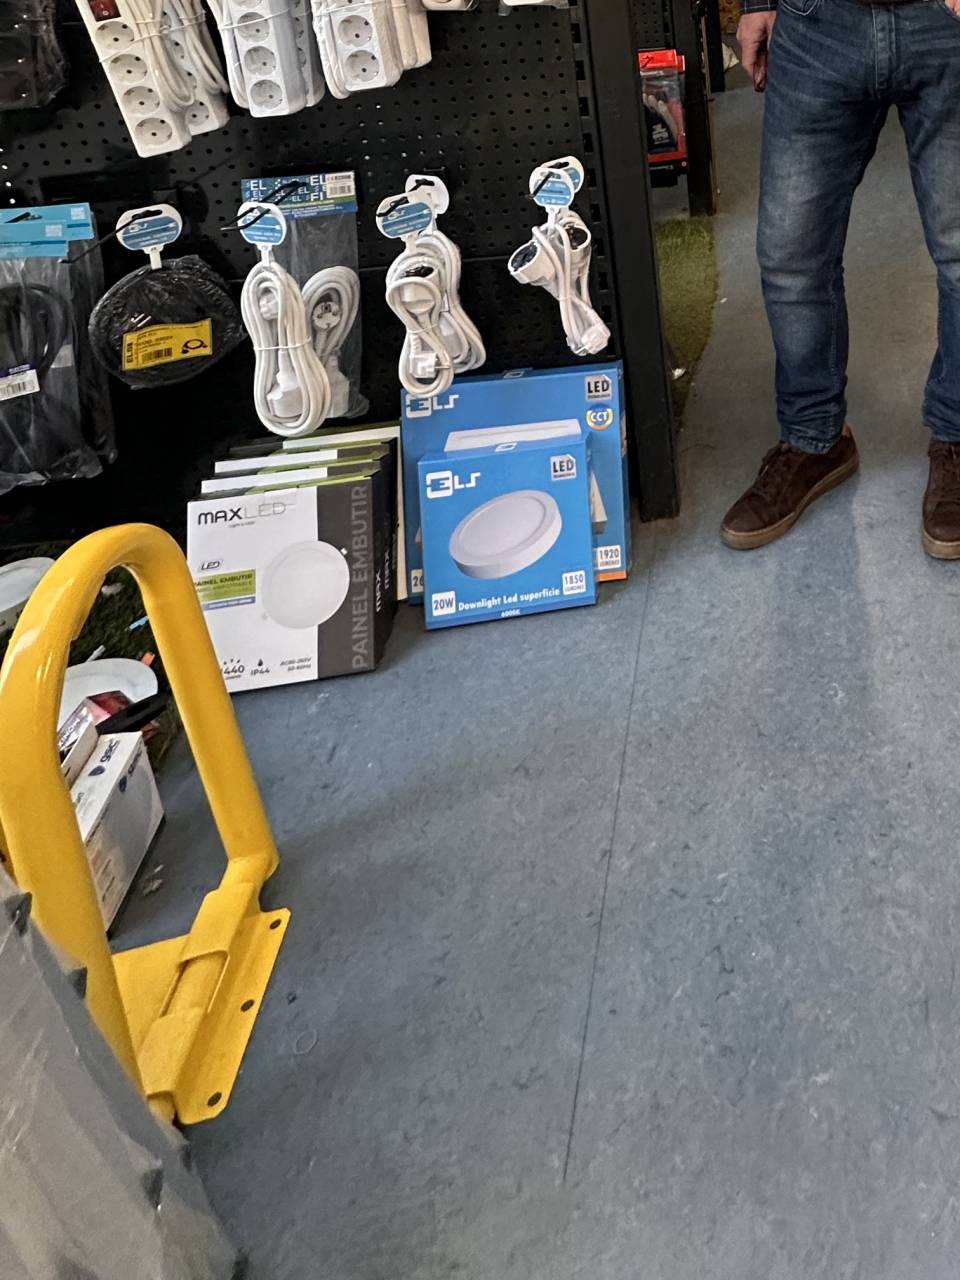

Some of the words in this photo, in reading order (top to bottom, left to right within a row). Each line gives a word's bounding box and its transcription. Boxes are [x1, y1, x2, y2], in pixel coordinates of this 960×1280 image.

[587, 379, 610, 394] LED
[590, 411, 608, 422] CCT
[553, 458, 574, 474] LED
[352, 485, 368, 582] EMBUTIR
[599, 549, 619, 560] 1920
[201, 561, 220, 571] LED
[565, 573, 584, 586] 1850
[433, 597, 454, 610] 20W
[458, 597, 501, 611] Downlight
[503, 594, 517, 604] Led
[520, 587, 560, 603] superficie
[352, 591, 368, 670] PAINEL
[251, 667, 270, 676] IP44
